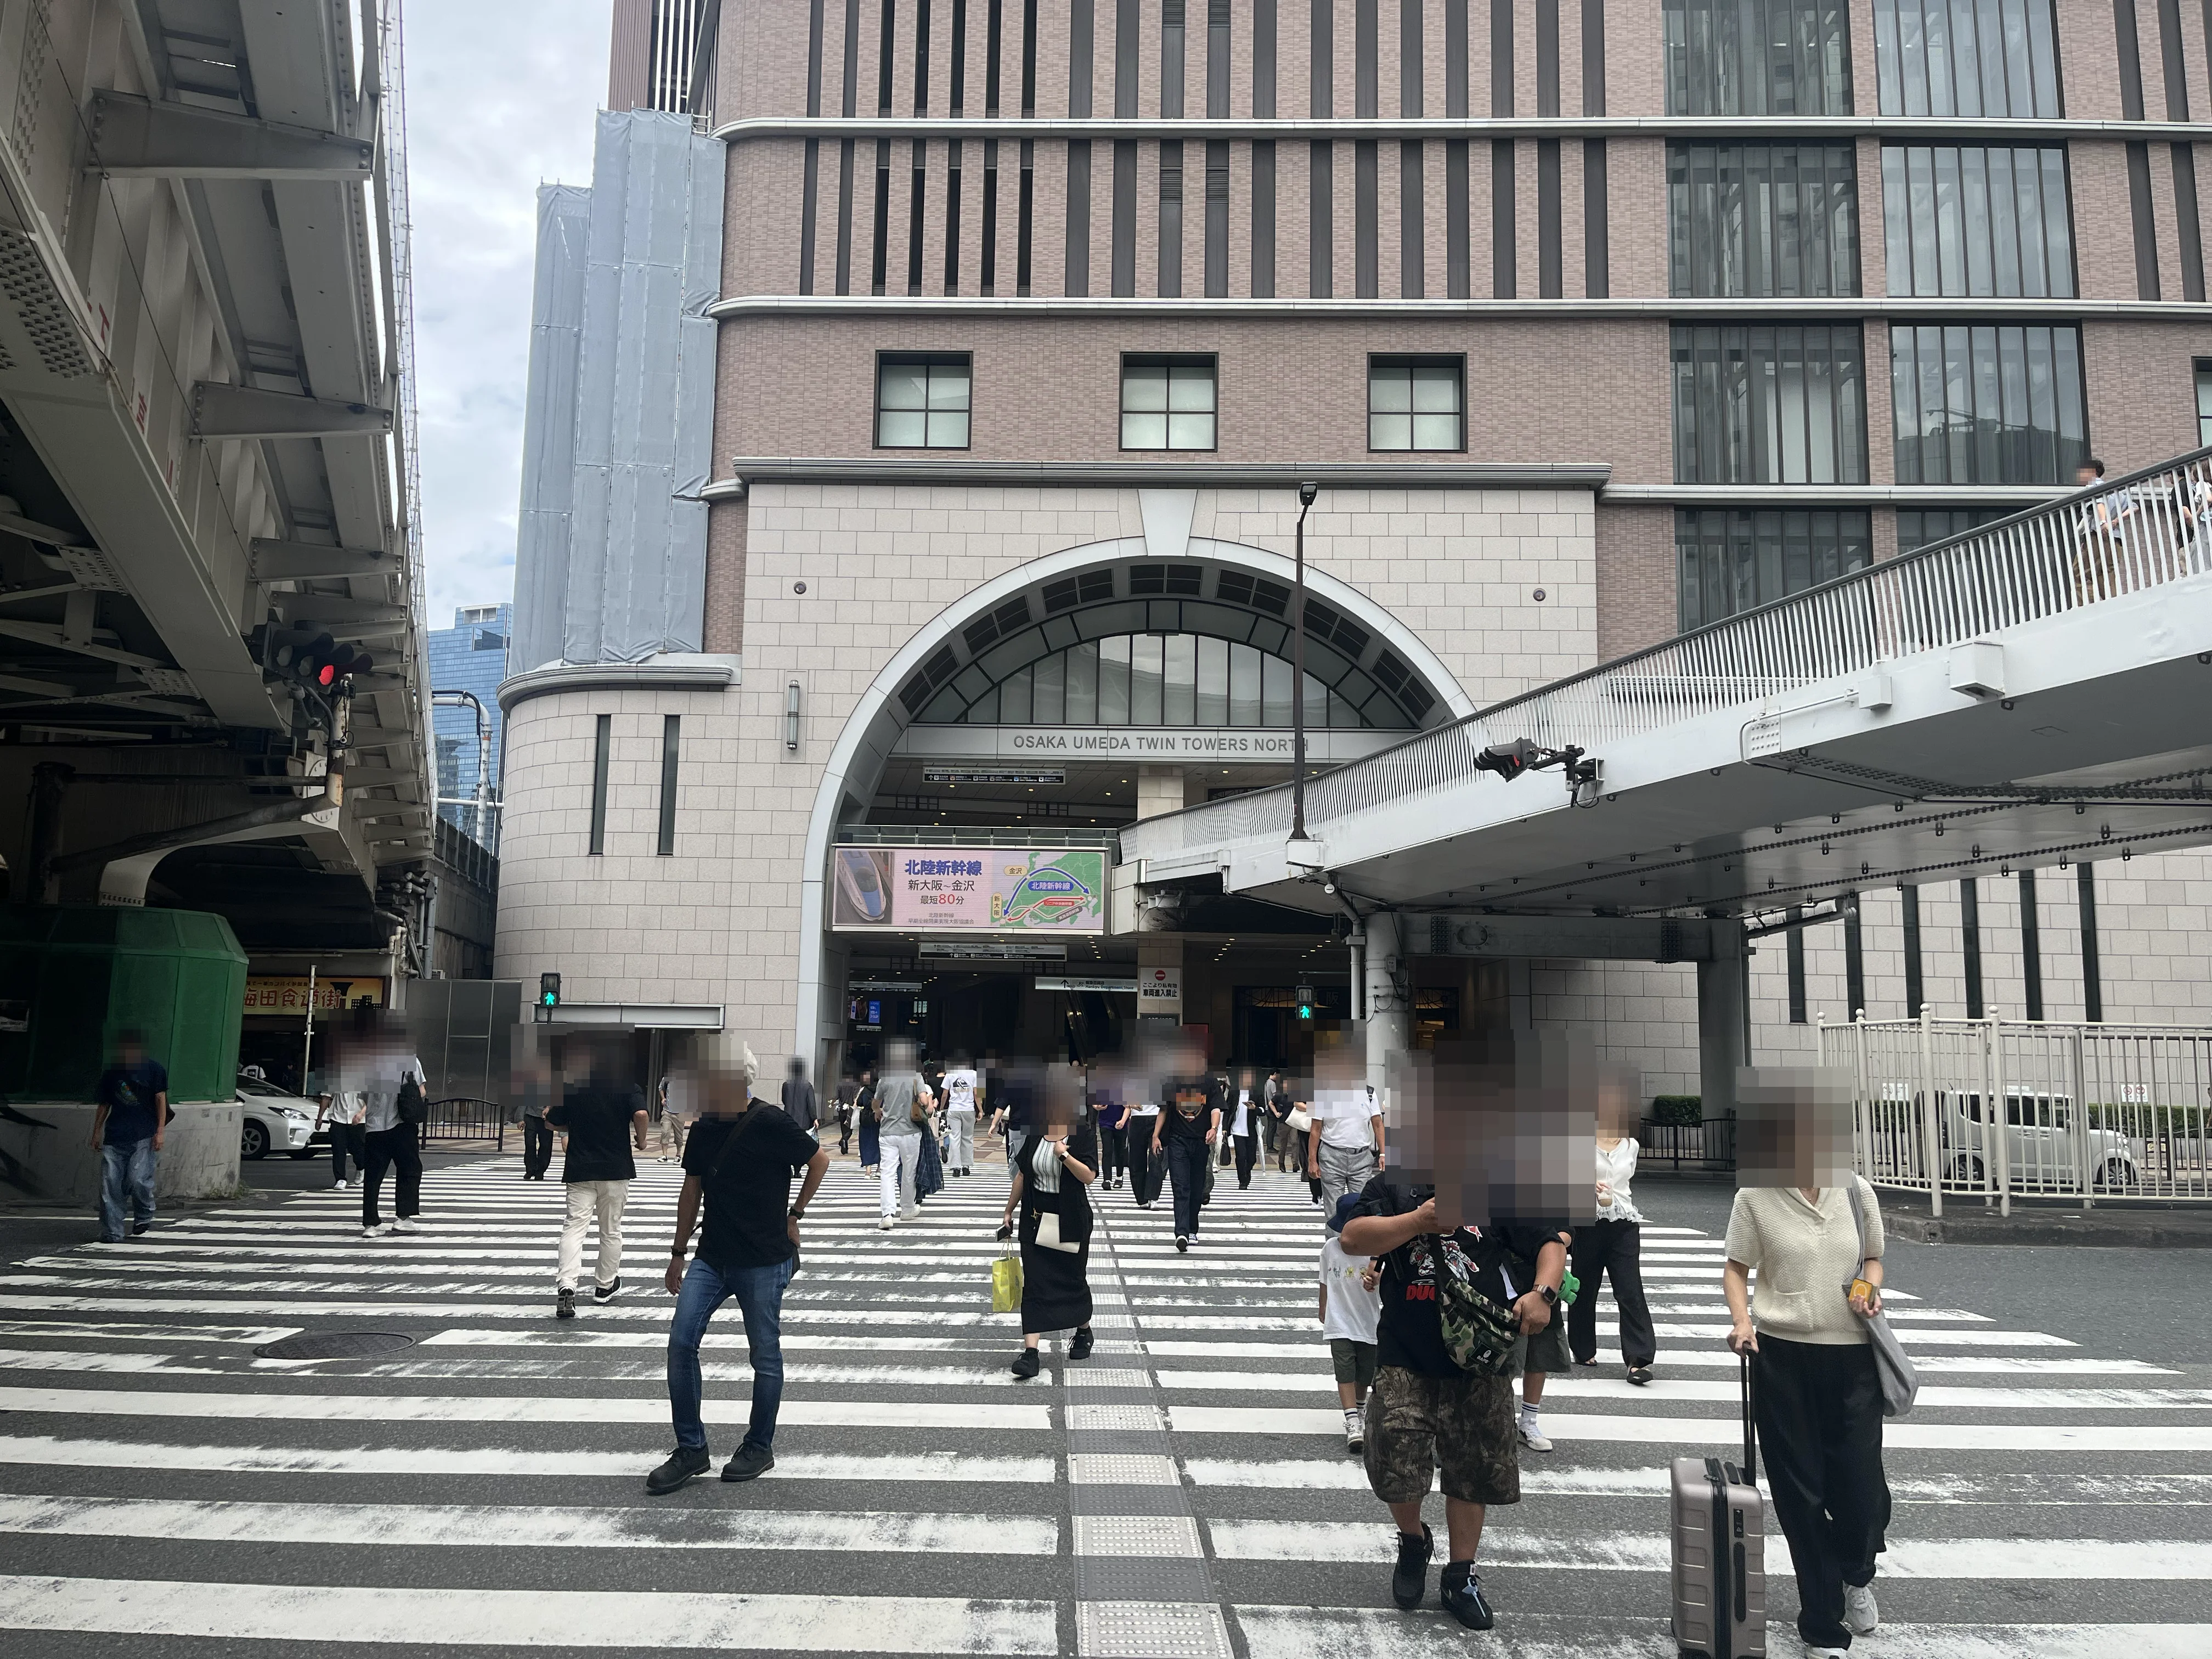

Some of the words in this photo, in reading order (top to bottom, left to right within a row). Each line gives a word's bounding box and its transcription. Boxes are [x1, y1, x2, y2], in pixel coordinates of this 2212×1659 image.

[1014, 735, 1067, 749] OSAKA
[1074, 736, 1130, 749] UMEDA
[1136, 737, 1175, 750] TWIN
[1182, 737, 1248, 751] TOWERS
[905, 859, 982, 876] 北陸新幹線
[1031, 882, 1071, 890] 北陸新幹線
[921, 894, 964, 905] 最短80分
